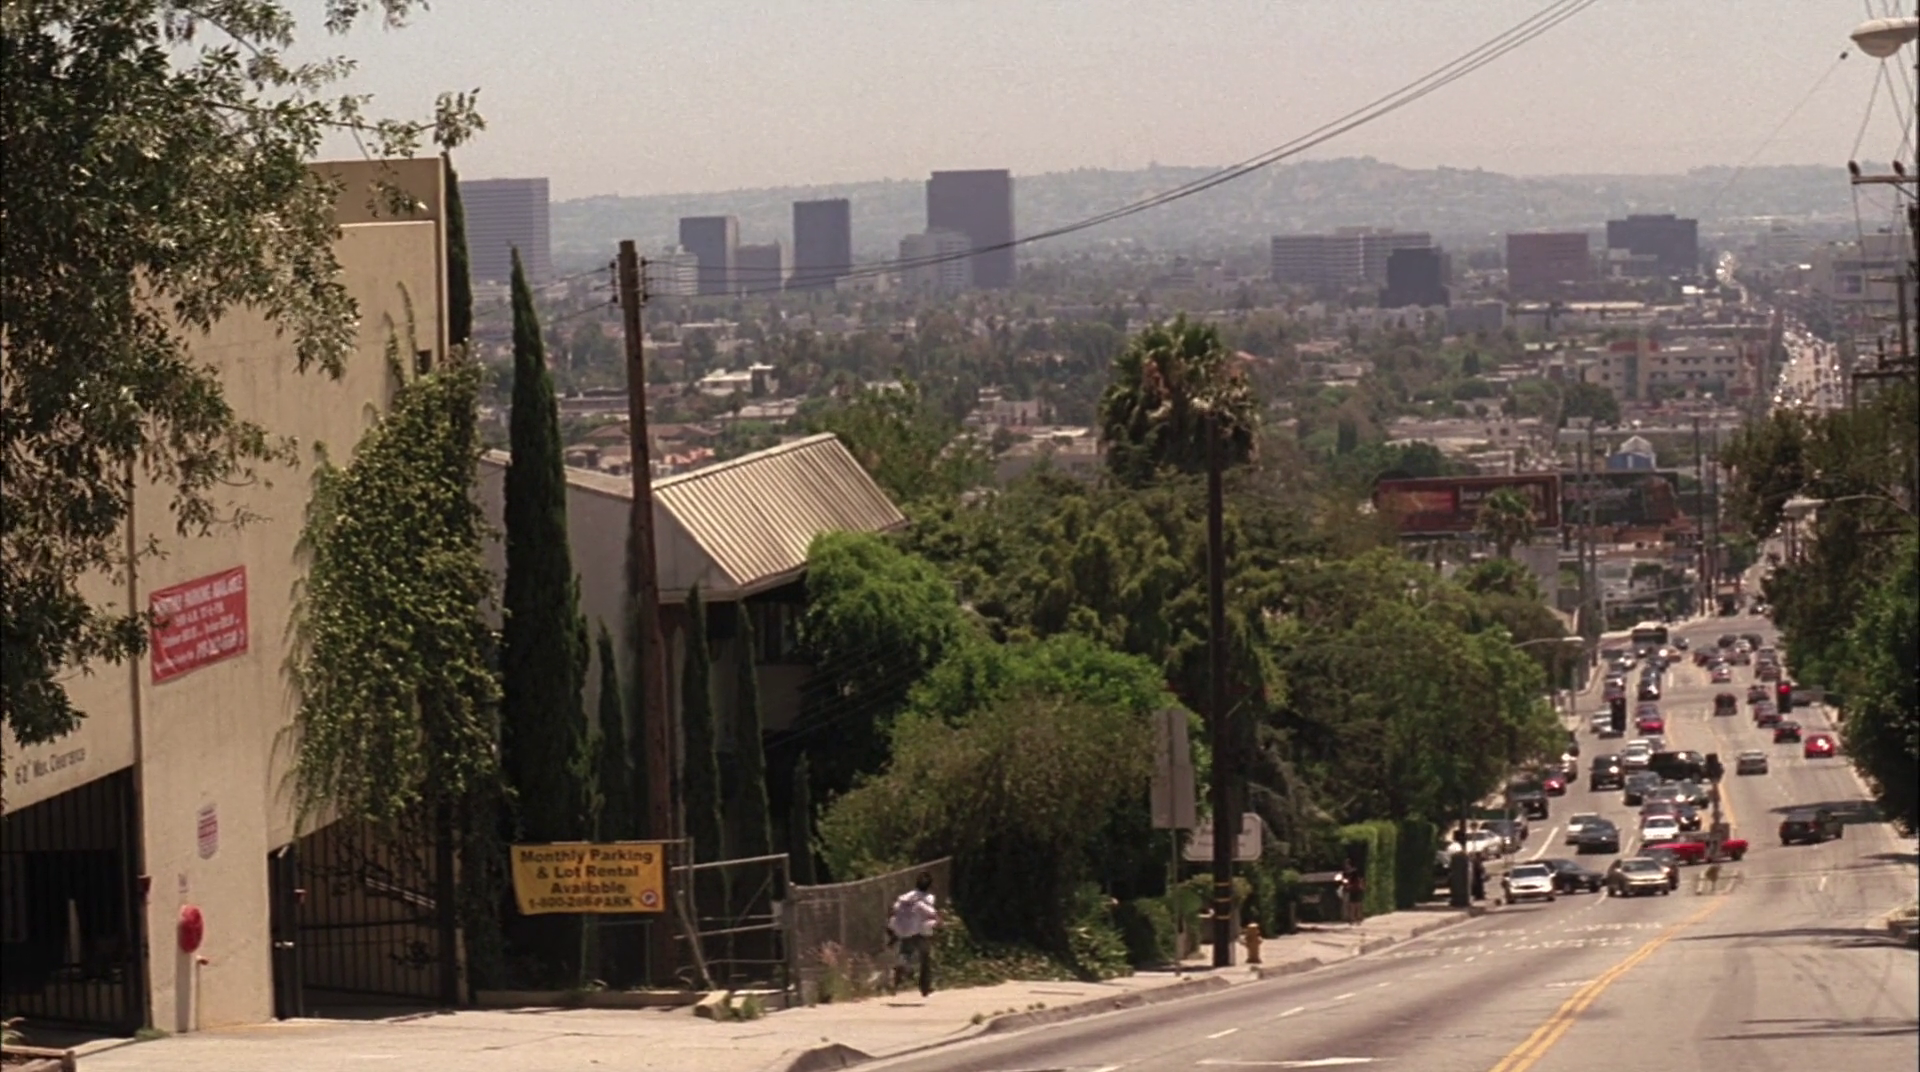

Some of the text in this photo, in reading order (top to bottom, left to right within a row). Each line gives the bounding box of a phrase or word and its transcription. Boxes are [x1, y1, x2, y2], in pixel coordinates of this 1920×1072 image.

[519, 849, 653, 864] Monthly Parking
[536, 865, 638, 879] & Lot Rental
[550, 882, 626, 894] Available
